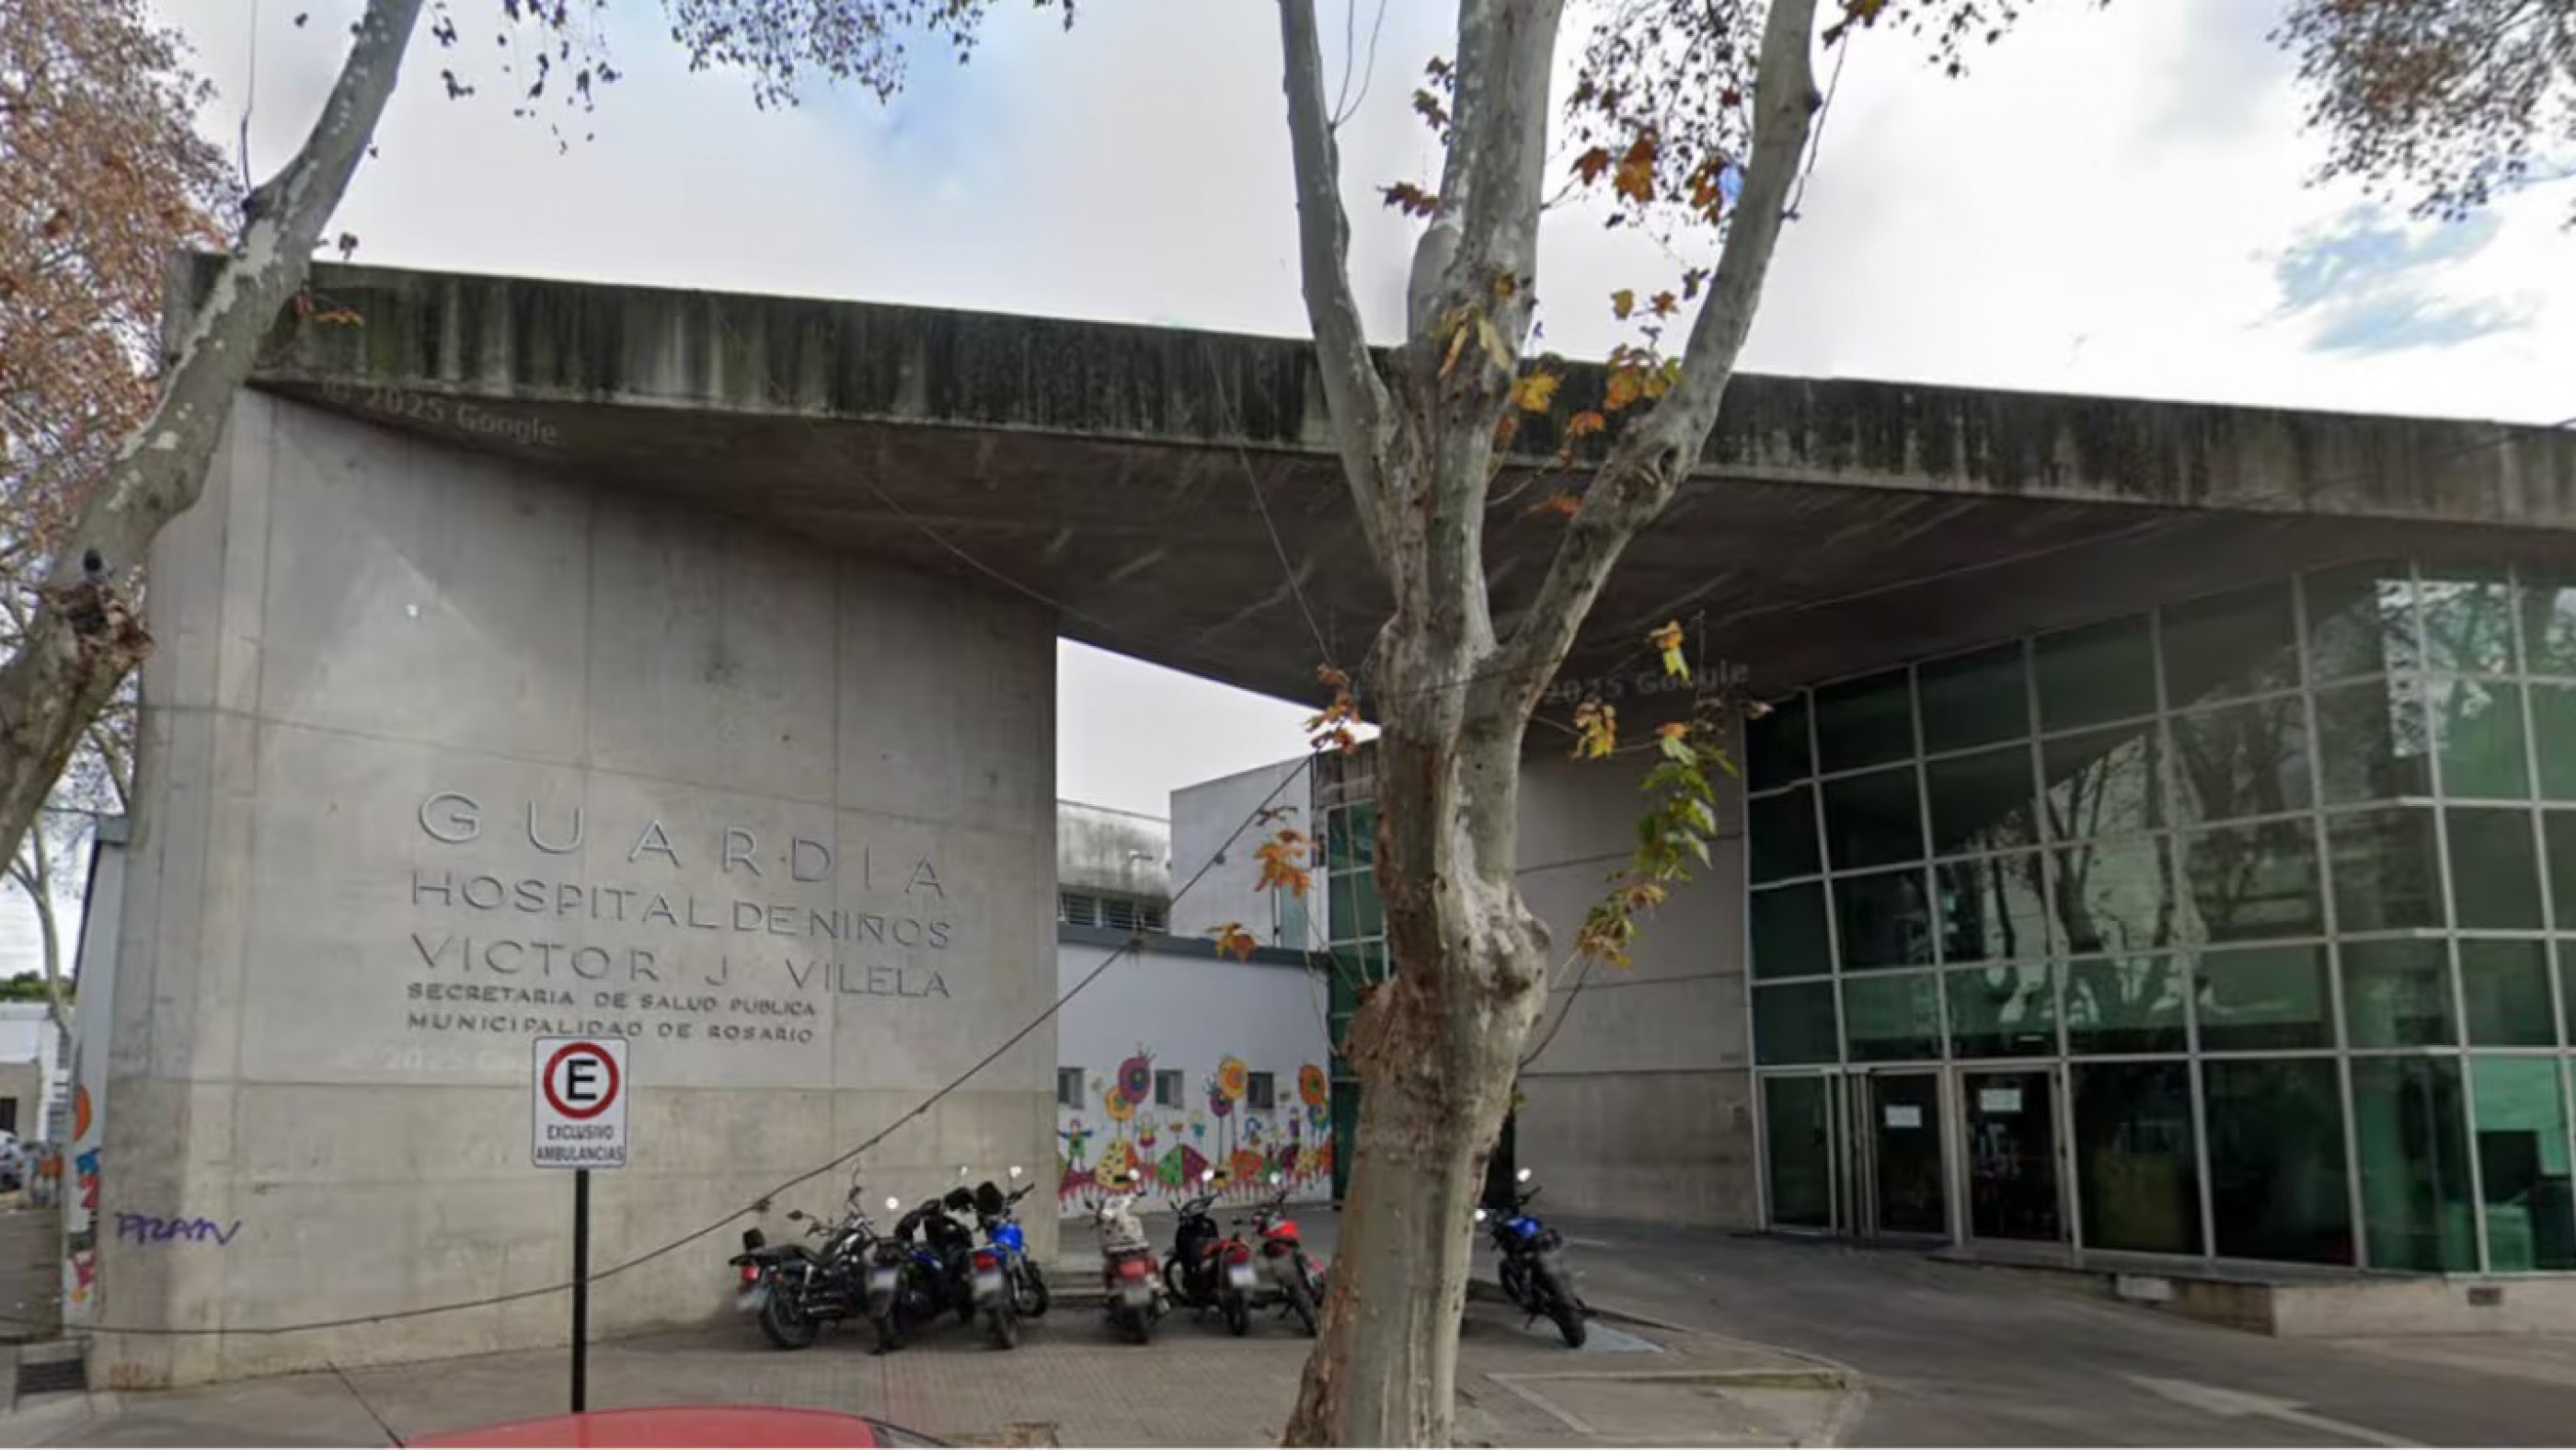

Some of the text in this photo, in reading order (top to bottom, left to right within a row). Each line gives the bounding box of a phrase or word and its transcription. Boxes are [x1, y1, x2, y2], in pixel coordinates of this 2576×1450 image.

[419, 791, 945, 899] GUARDIA
[411, 870, 721, 931] HOSPITAL
[733, 899, 799, 936] DE
[410, 932, 951, 999] VICTOR J VILELA
[407, 981, 575, 1006] SECRETARIA
[594, 991, 628, 1009] DE
[640, 993, 718, 1013] SALUD
[407, 1013, 813, 1043] MUNICIPALIDAD DE ROSARIO
[567, 1059, 598, 1100] E
[546, 1123, 614, 1140] EXCLUSIVO
[536, 1145, 626, 1159] AMBULANCIAS
